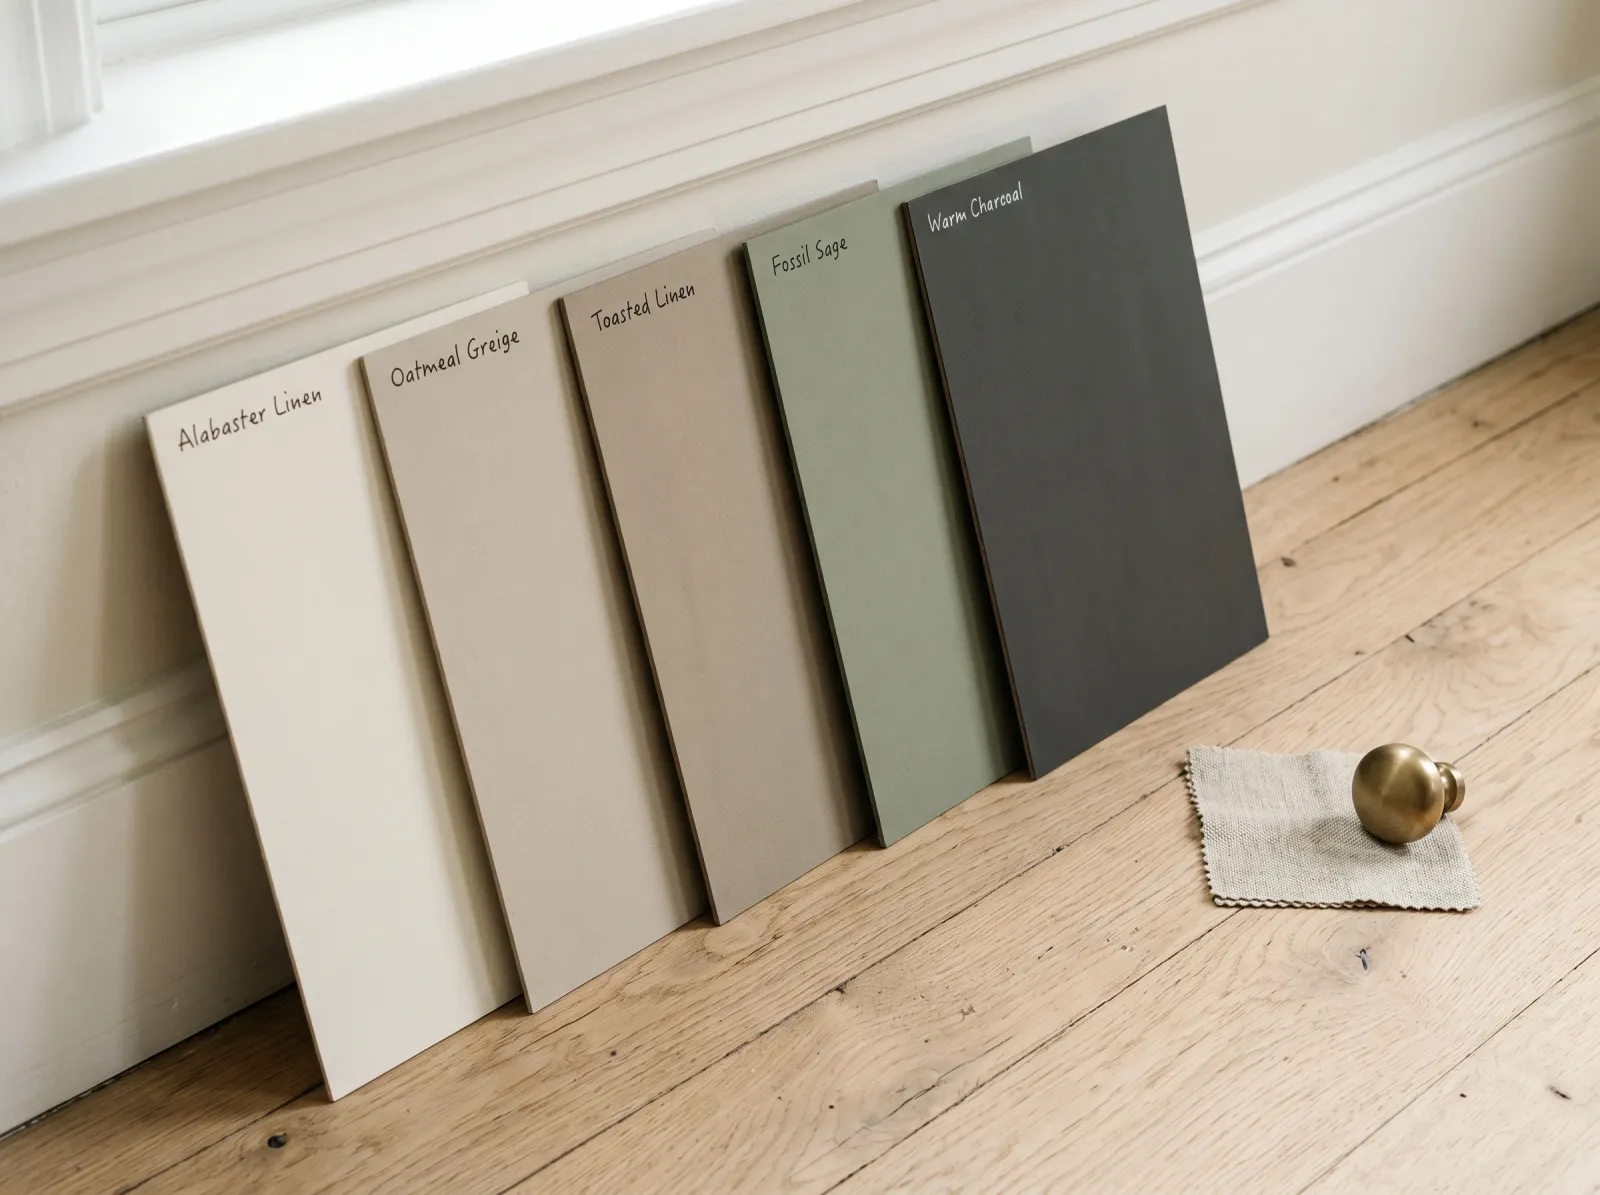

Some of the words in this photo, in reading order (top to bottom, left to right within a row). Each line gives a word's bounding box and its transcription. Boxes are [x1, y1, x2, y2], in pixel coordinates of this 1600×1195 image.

[927, 211, 968, 233] Warm
[970, 180, 1024, 218] Charcoal
[771, 243, 811, 277] Fossil
[815, 238, 848, 261] Sage
[590, 292, 652, 332] Toasted
[654, 284, 696, 309] Linen
[390, 343, 461, 388] Oatmeal
[467, 329, 520, 361] Greige
[178, 408, 267, 452] Alabaster
[273, 389, 322, 416] Linen
